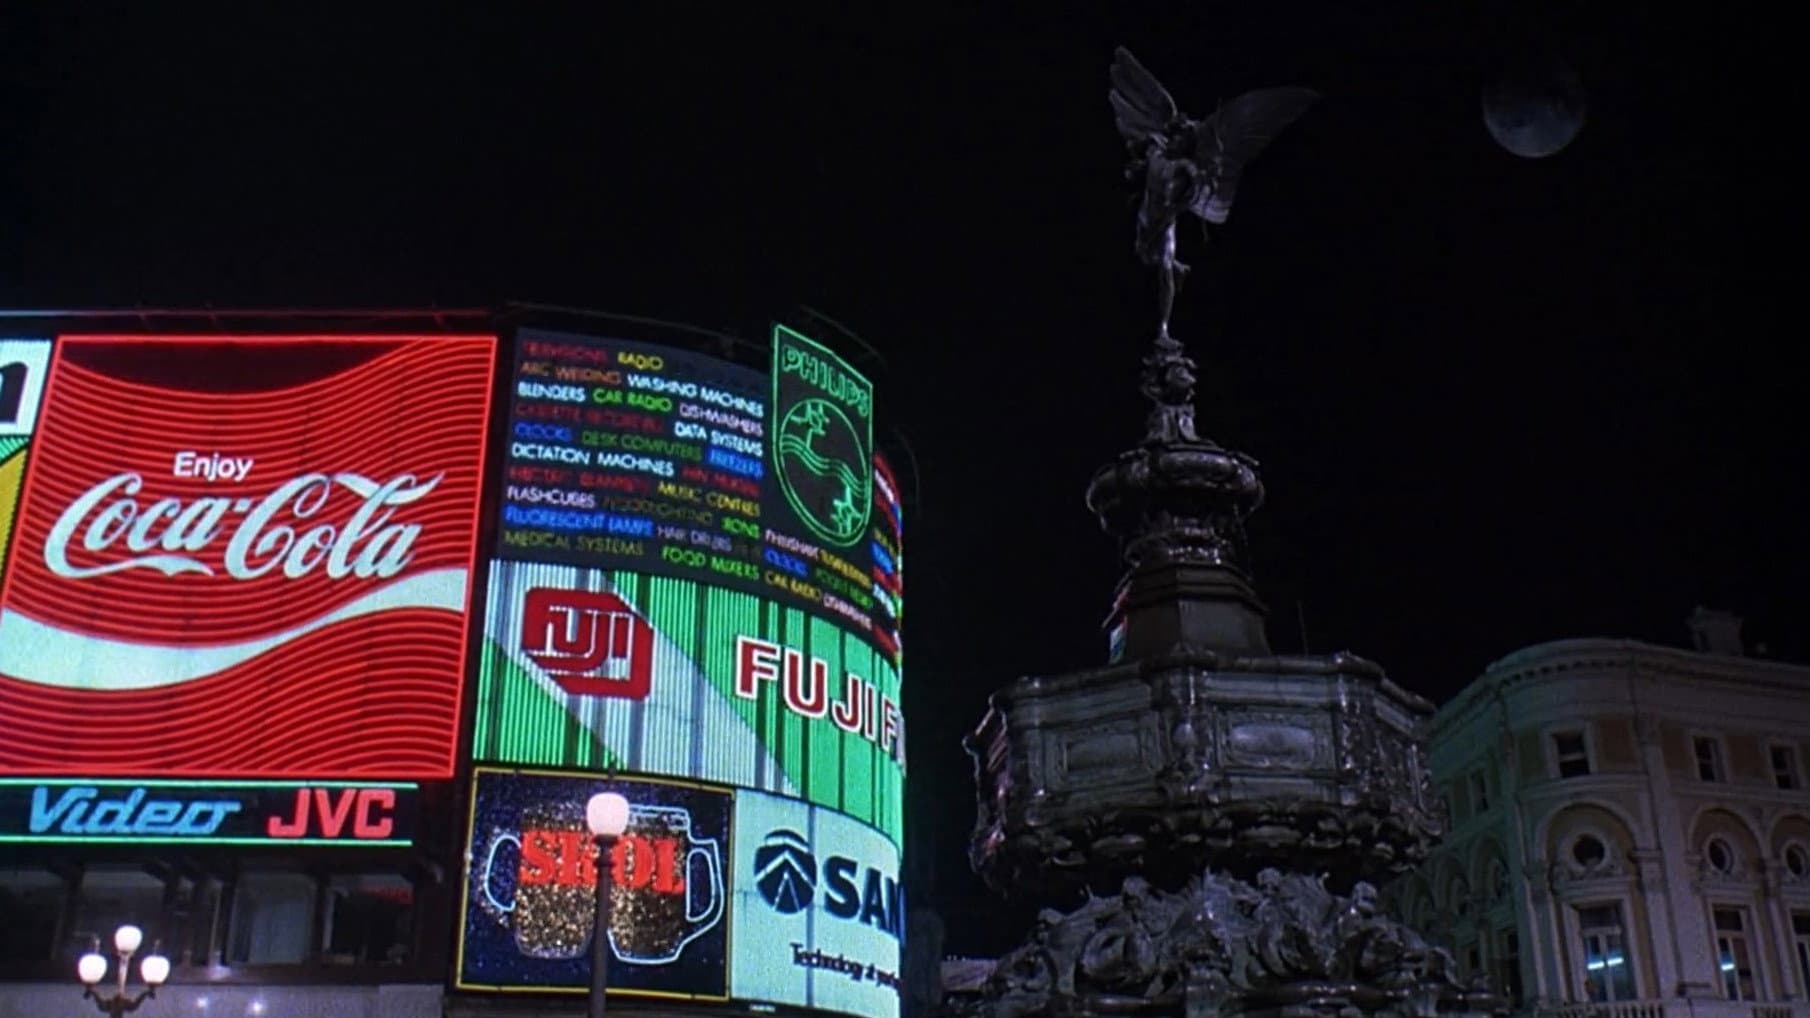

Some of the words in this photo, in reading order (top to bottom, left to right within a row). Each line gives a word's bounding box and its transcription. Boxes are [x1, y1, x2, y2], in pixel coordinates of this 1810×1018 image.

[617, 352, 664, 370] RADIO
[783, 344, 868, 417] PHILIPS
[517, 381, 586, 402] BLENDERS
[593, 388, 622, 404] CAR
[627, 392, 673, 413] RADIO
[679, 402, 763, 437] DISHWASHERS
[627, 373, 698, 398] WASHING
[701, 387, 764, 418] MACHINES
[581, 430, 617, 447] DESK
[674, 421, 708, 440] DATA
[711, 429, 763, 457] SYSTEMS
[173, 451, 255, 482] Enjoy
[511, 443, 591, 465] DICTATION
[598, 453, 674, 477] MACHINES
[507, 486, 596, 509] FLASHCUBES
[44, 470, 447, 580] Coca-Cola
[505, 506, 605, 531] FLUORESCENT
[504, 531, 570, 548] MEDICAL
[577, 536, 644, 556] SYSTEMS
[661, 546, 706, 567] FOOD
[711, 557, 760, 581] MIXERS
[28, 785, 242, 836] Video
[267, 788, 396, 838] JVC
[518, 829, 686, 895] SKOL
[790, 942, 864, 982] Technology
